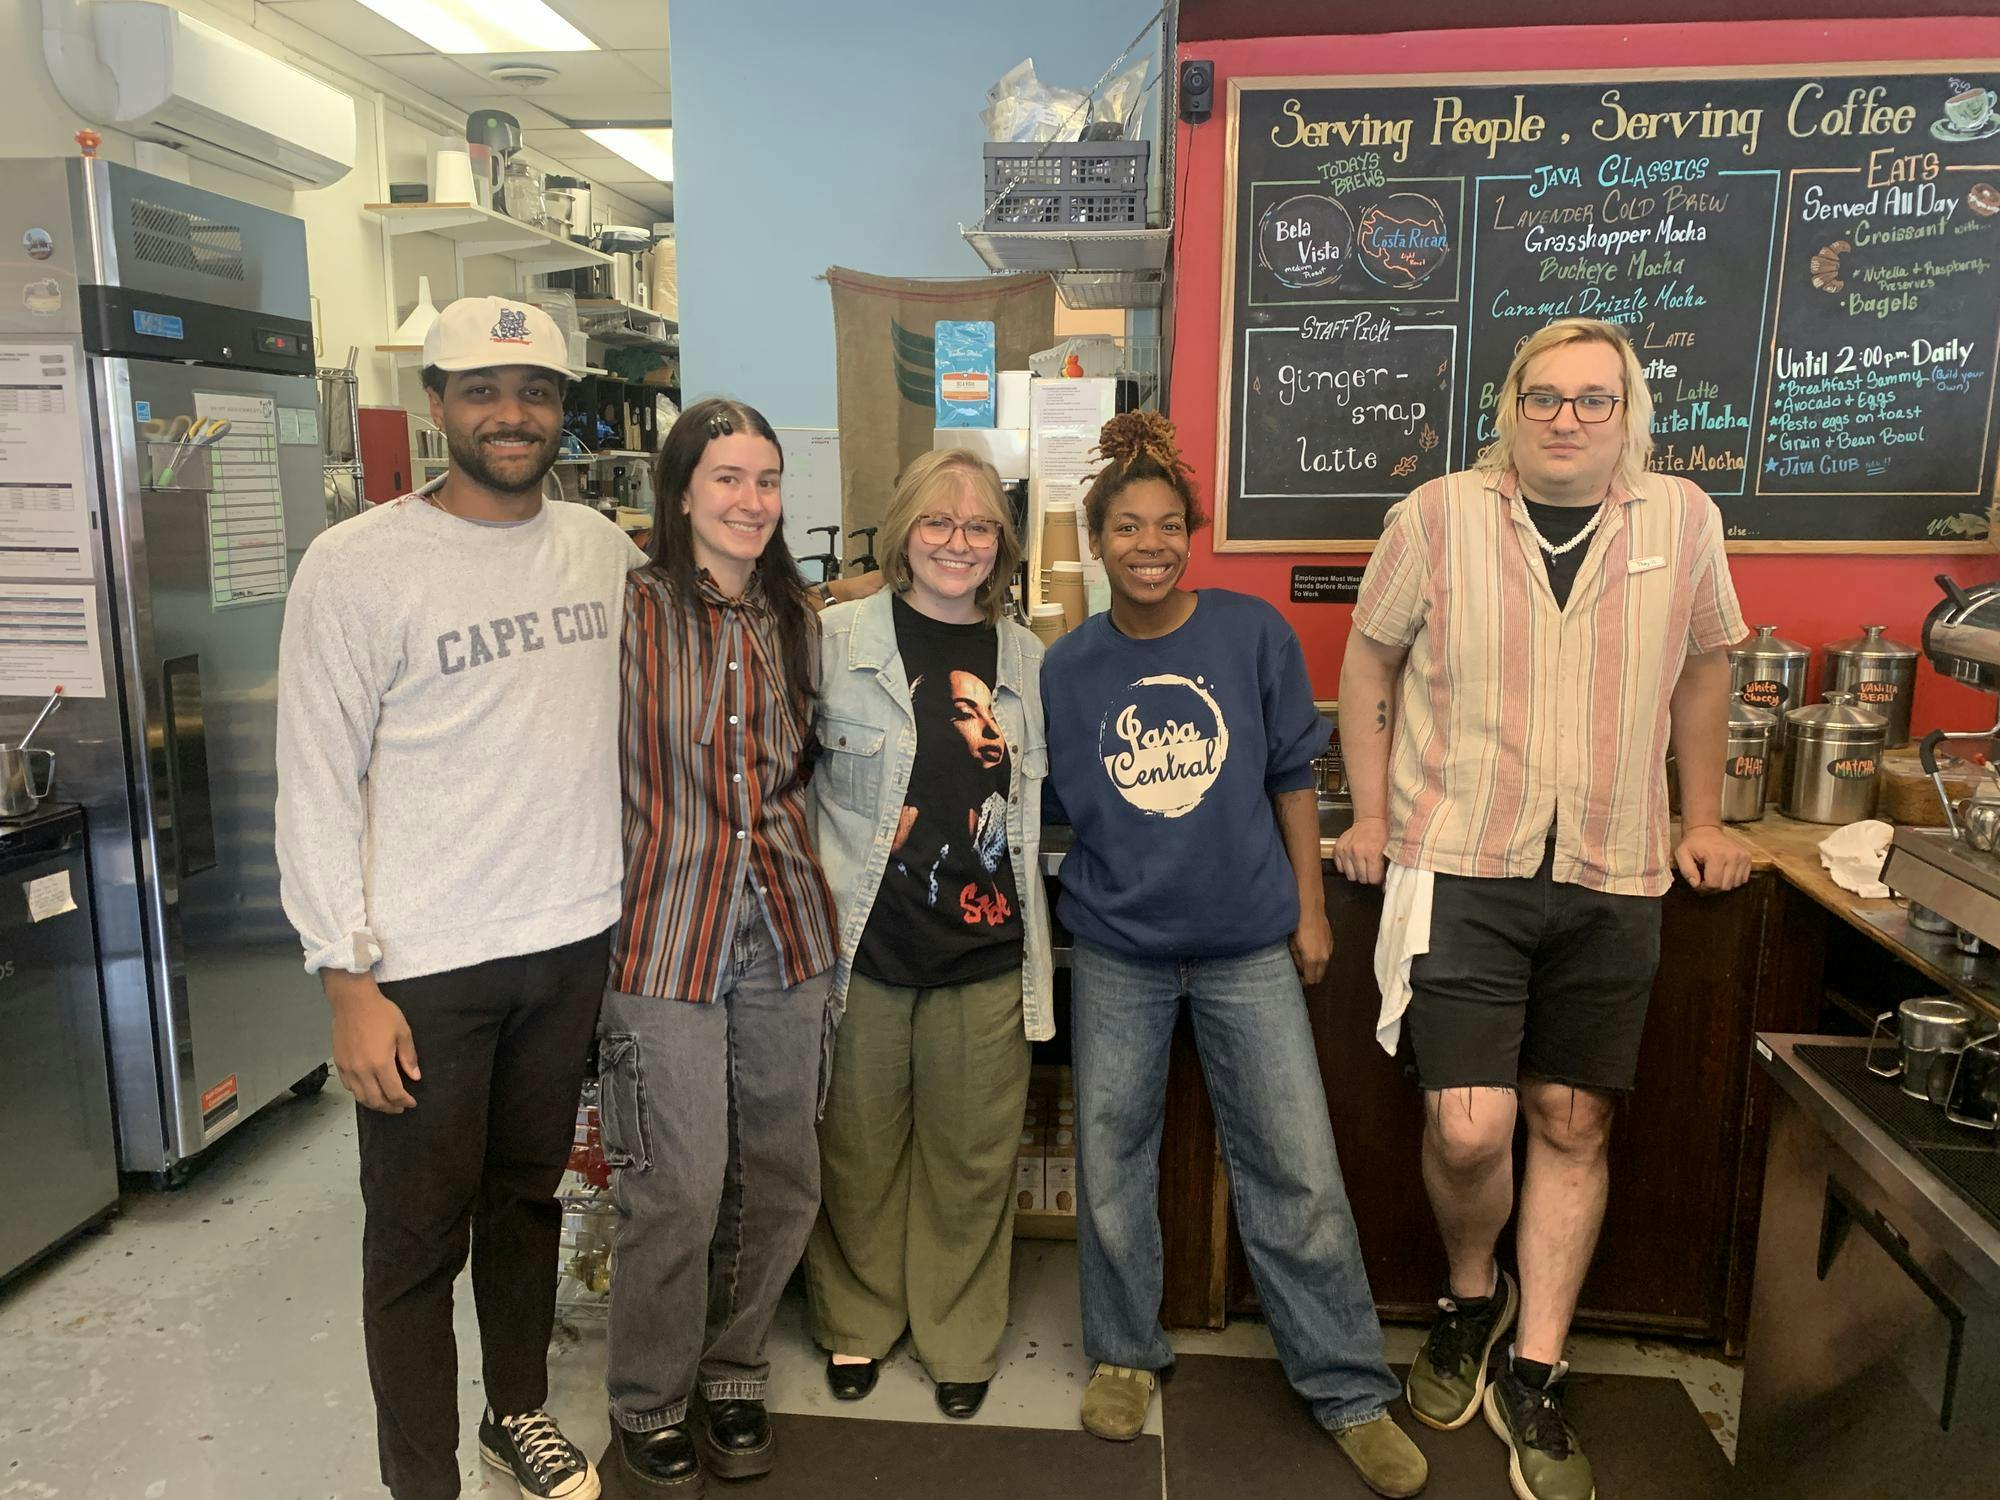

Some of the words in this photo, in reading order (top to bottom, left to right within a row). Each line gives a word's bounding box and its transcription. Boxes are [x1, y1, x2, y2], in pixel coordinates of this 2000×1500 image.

[1271, 98, 1413, 162] Serving
[1591, 89, 1764, 155] Serving
[1787, 83, 1916, 138] Coffee
[1318, 152, 1381, 180] TODAYS
[1529, 165, 1582, 198] JAVA
[1598, 154, 1709, 189] CLASSICS
[1867, 148, 1940, 188] EATS
[1331, 169, 1387, 196] BREWS
[1494, 195, 1594, 230] LAVENDER
[1602, 189, 1655, 223] COLD
[1662, 184, 1728, 214] BREW
[1803, 186, 1878, 221] Served
[1884, 187, 1913, 216] All
[1917, 183, 1960, 220] Day
[1276, 219, 1311, 241] Bela
[1372, 226, 1406, 249] Costa
[1408, 225, 1448, 248] Rican
[1525, 224, 1652, 255] Grasshopper
[1655, 215, 1707, 244] Mocha
[1855, 216, 1947, 246] Croissant
[1298, 240, 1340, 265] Vista
[1539, 256, 1618, 285] Buckeye
[1628, 249, 1685, 281] Mocha
[1863, 266, 1909, 282] Nutella
[1492, 289, 1571, 318] Caramel
[1579, 287, 1648, 315] Drizzle
[1654, 280, 1707, 310] Mocha
[1879, 279, 1935, 291] Preserves
[1850, 292, 1918, 318] Bagels
[1301, 315, 1354, 340] STAFF
[1644, 322, 1695, 349] LATTE
[1642, 358, 1678, 379] atte
[1776, 347, 1828, 379] Until
[1911, 338, 1975, 367] Daily
[1278, 365, 1409, 406] ginger-
[1676, 378, 1719, 403] Latte
[1787, 373, 1864, 396] Breakfast
[1867, 369, 1929, 389] Sammy
[1783, 397, 1841, 414] Avocado
[1858, 390, 1896, 411] Eggs
[1351, 402, 1426, 436] snap
[1649, 408, 1688, 434] hite
[1691, 401, 1750, 431] Mocha
[1778, 414, 1817, 432] Pesto
[1822, 415, 1850, 433] eggs
[1856, 412, 1874, 424] on
[1877, 406, 1922, 423] toast
[1780, 433, 1819, 451] Grain
[1837, 432, 1875, 449] Bean
[1880, 426, 1924, 445] Bowl
[1297, 436, 1377, 472] latte
[1648, 445, 1684, 472] hite
[1687, 444, 1746, 472] Mocha
[1779, 455, 1814, 477] JAVA
[1820, 454, 1859, 474] CLUB
[437, 611, 545, 675] CAPE
[552, 601, 608, 645] COD
[1746, 681, 1777, 694] White
[1858, 692, 1894, 702] BEAN
[1116, 704, 1201, 751] Java
[1112, 737, 1217, 790] Central
